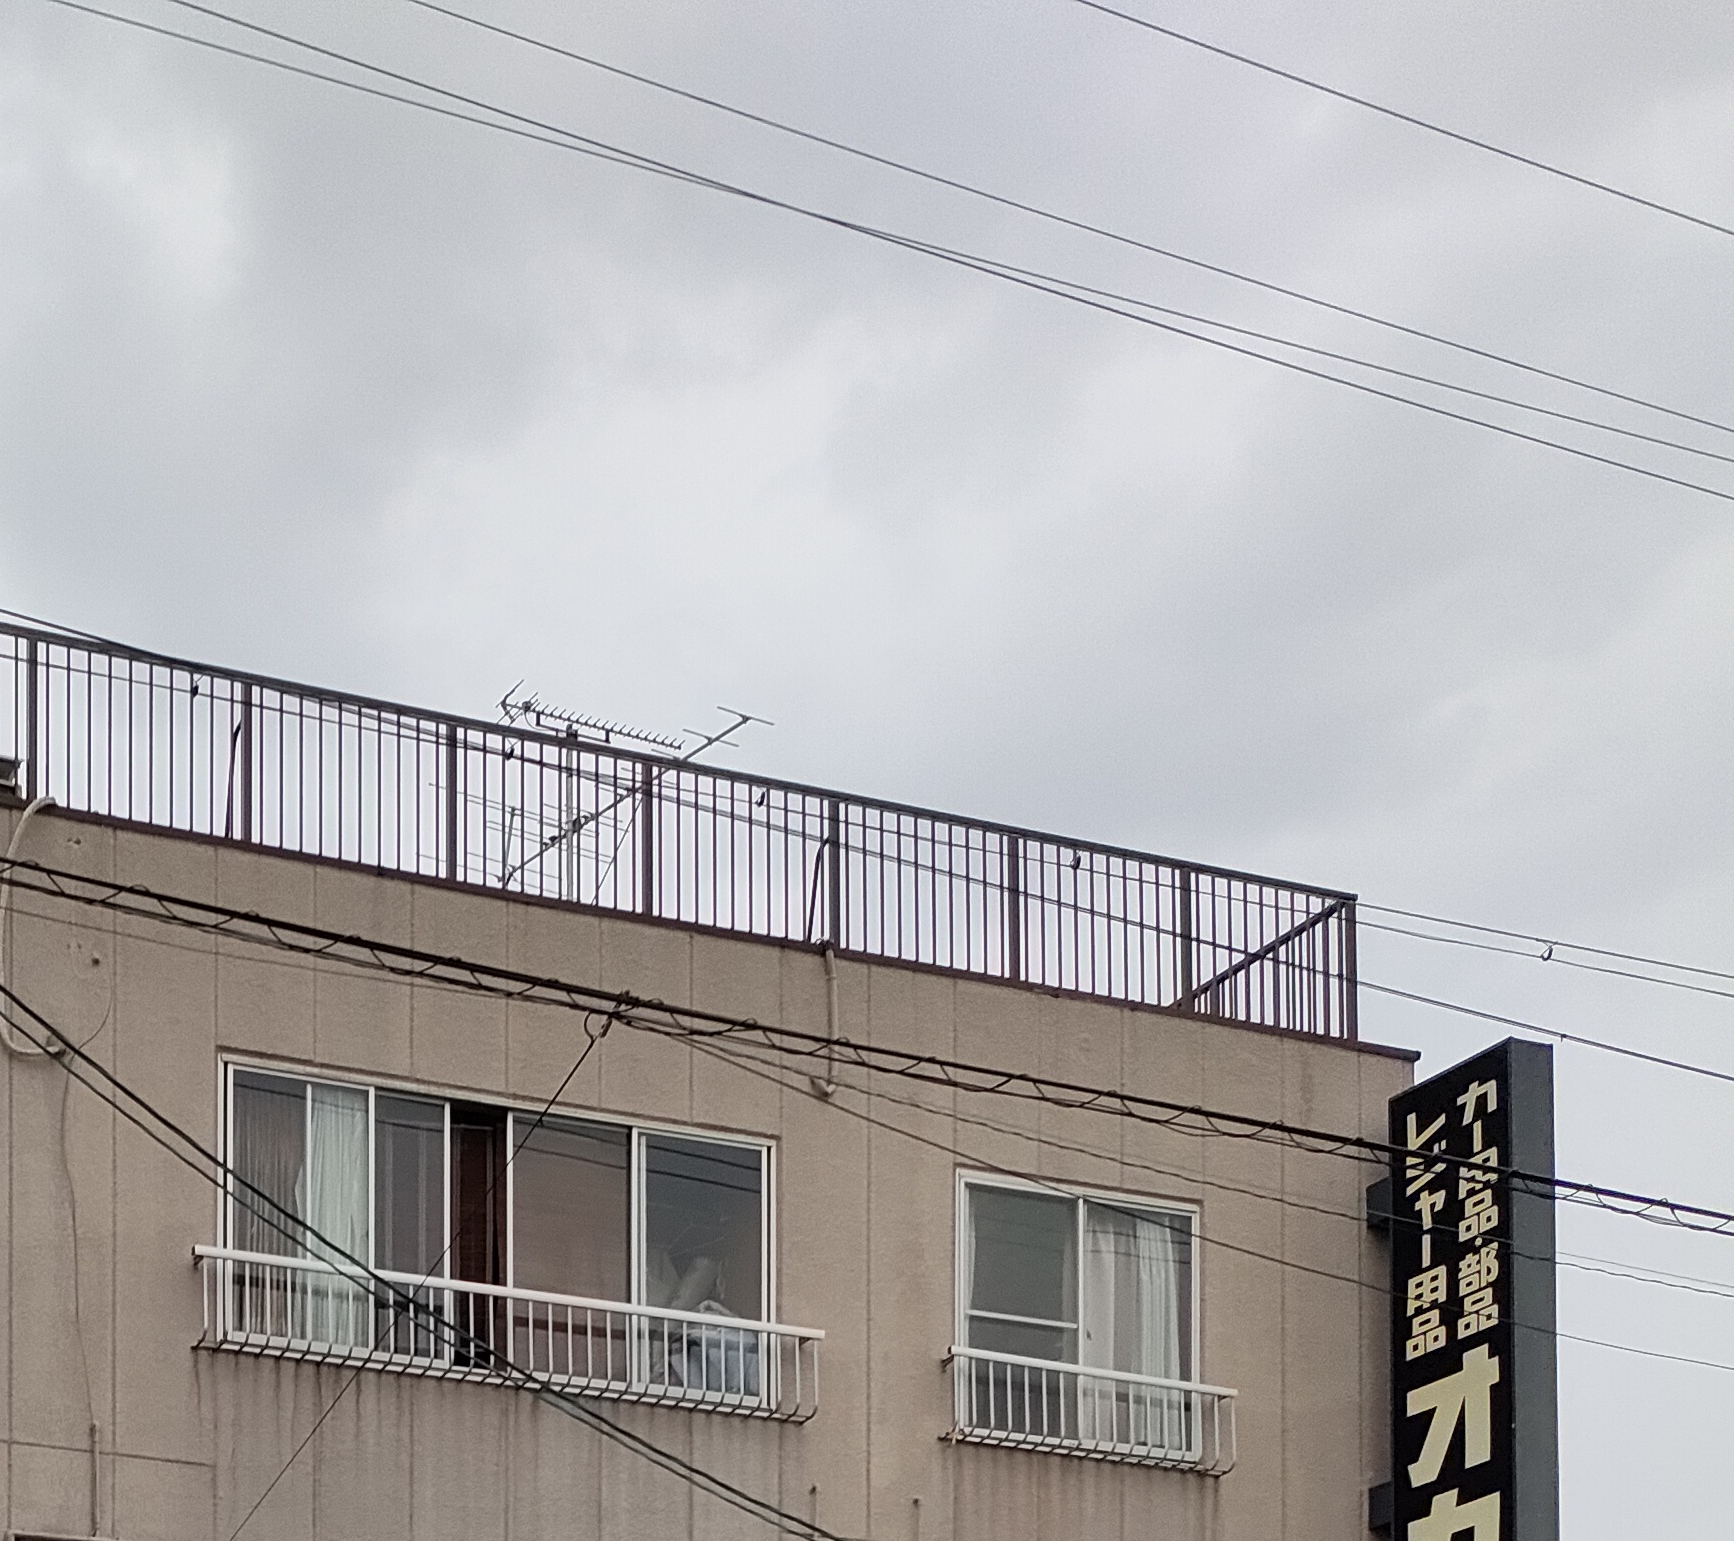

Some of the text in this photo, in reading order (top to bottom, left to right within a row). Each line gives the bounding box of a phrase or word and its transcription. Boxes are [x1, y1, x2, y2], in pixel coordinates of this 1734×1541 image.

[1406, 1112, 1447, 1362] レジャー用品
